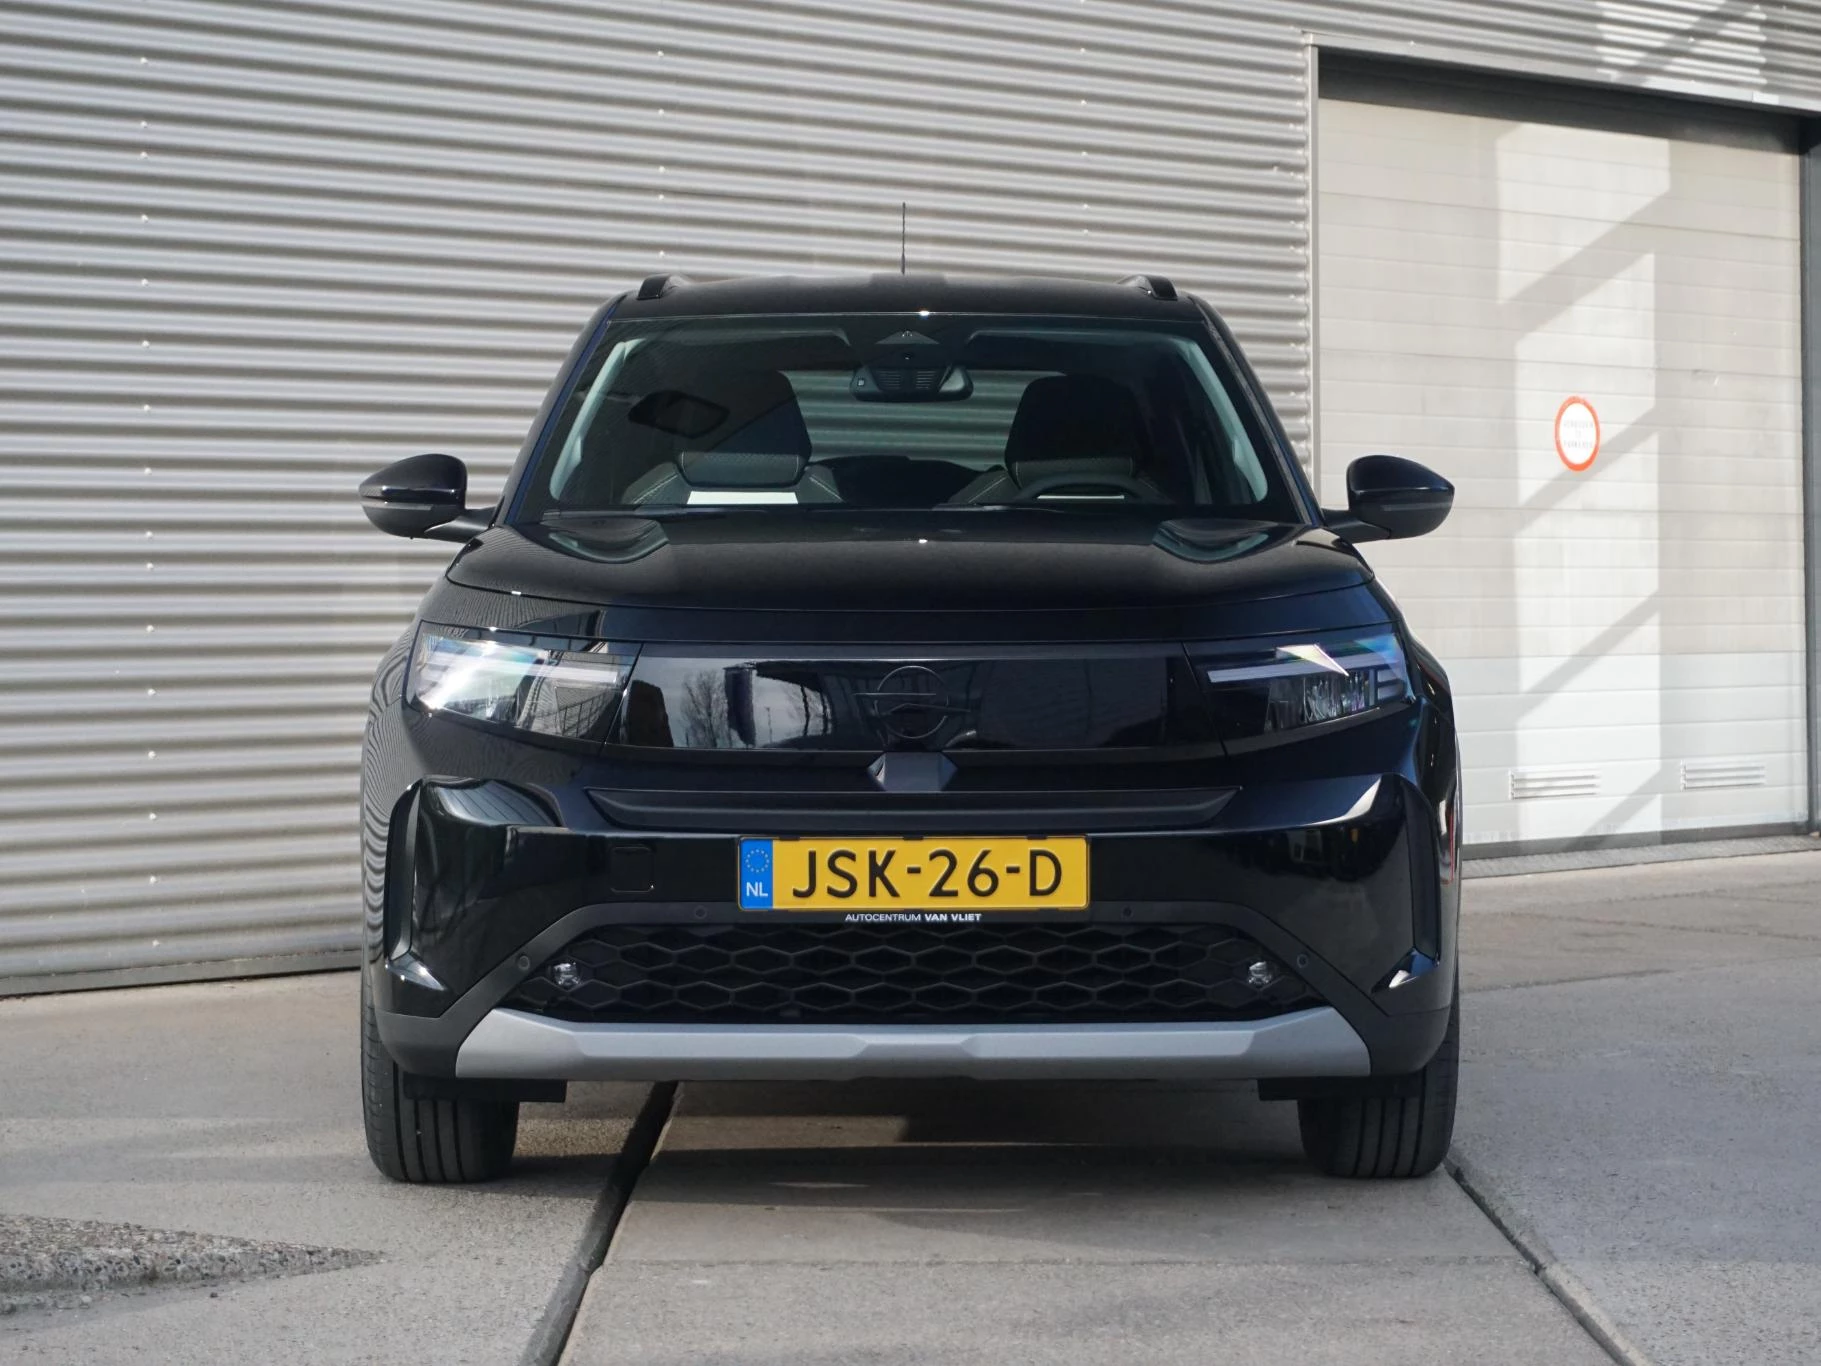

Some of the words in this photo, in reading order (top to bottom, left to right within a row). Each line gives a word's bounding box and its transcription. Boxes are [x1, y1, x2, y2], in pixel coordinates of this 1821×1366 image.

[792, 848, 1062, 898] JSK-26-D
[745, 881, 769, 897] NL
[845, 913, 921, 922] AUTOCENTRUM
[924, 913, 948, 922] VAN
[951, 913, 982, 922] VLIET
